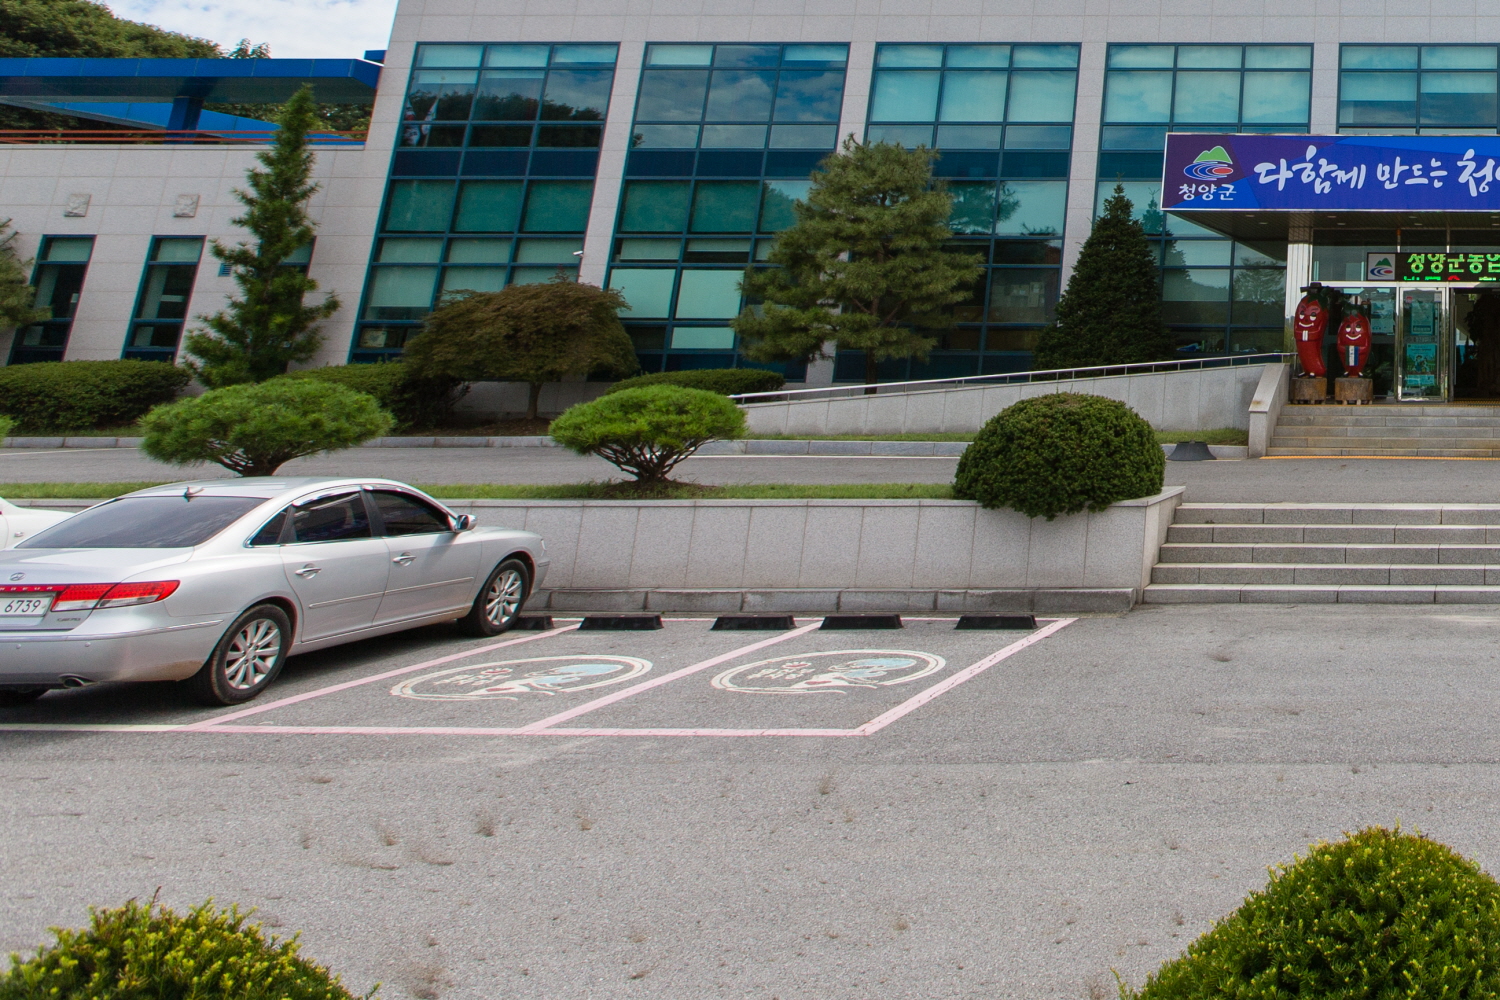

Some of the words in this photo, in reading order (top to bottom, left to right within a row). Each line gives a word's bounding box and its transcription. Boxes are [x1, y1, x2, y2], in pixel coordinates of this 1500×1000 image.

[1254, 145, 1366, 194] 다함께
[1377, 156, 1447, 188] 만드는
[1178, 183, 1237, 201] 청양군
[4, 600, 41, 613] 6739
